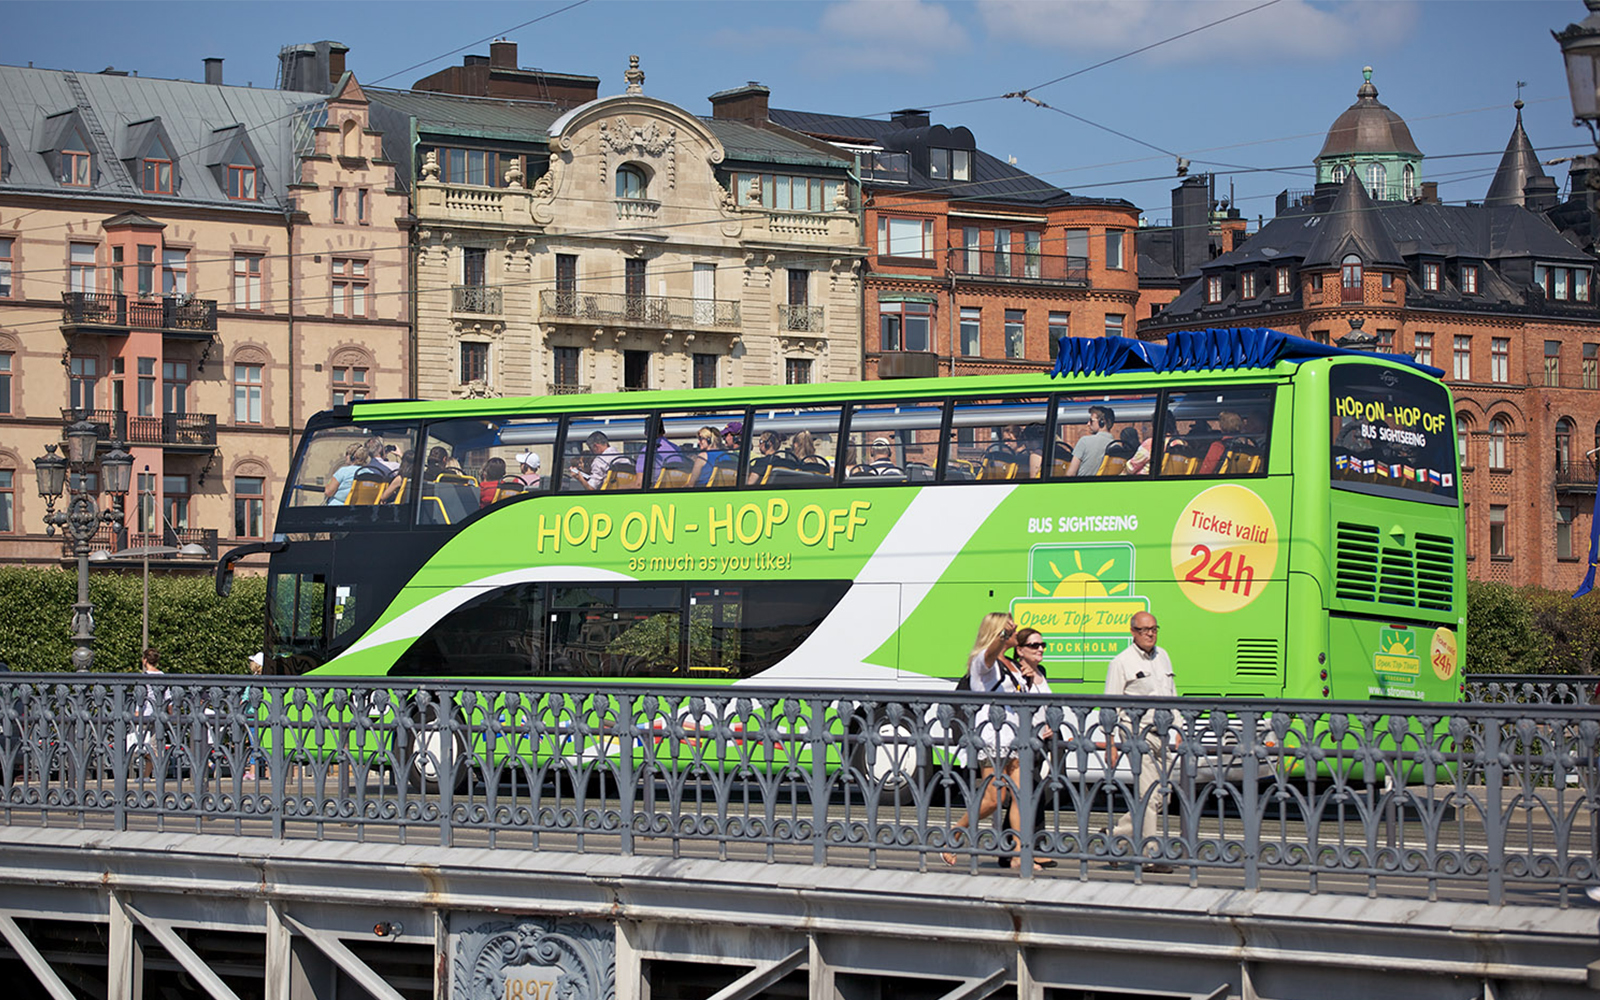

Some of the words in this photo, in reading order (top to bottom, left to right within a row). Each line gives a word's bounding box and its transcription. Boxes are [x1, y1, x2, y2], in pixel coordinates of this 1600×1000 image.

[1336, 396, 1363, 419] HOP
[1365, 401, 1385, 422] ON
[1394, 406, 1421, 427] HOP
[1423, 413, 1445, 434] OFF
[1361, 424, 1377, 439] BUS
[1379, 427, 1426, 447] SIGHTSEEING
[537, 505, 612, 552] HOP
[620, 503, 676, 551] ON
[708, 497, 789, 545] HOP
[797, 500, 871, 549] OFF
[1028, 517, 1053, 533] BUS
[1058, 515, 1138, 533] SIGHTSEEING
[1191, 510, 1233, 536] Ticket
[1235, 524, 1269, 544] valid
[629, 557, 647, 571] as
[650, 553, 694, 571] much
[698, 556, 717, 571] as
[720, 556, 751, 574] you
[754, 553, 792, 570] like!
[1185, 543, 1255, 597] 24h
[1020, 611, 1058, 625] Open
[1063, 611, 1091, 632] Top
[1096, 610, 1133, 625] Tour
[1433, 648, 1451, 676] 24h
[505, 979, 553, 1000] 1897
